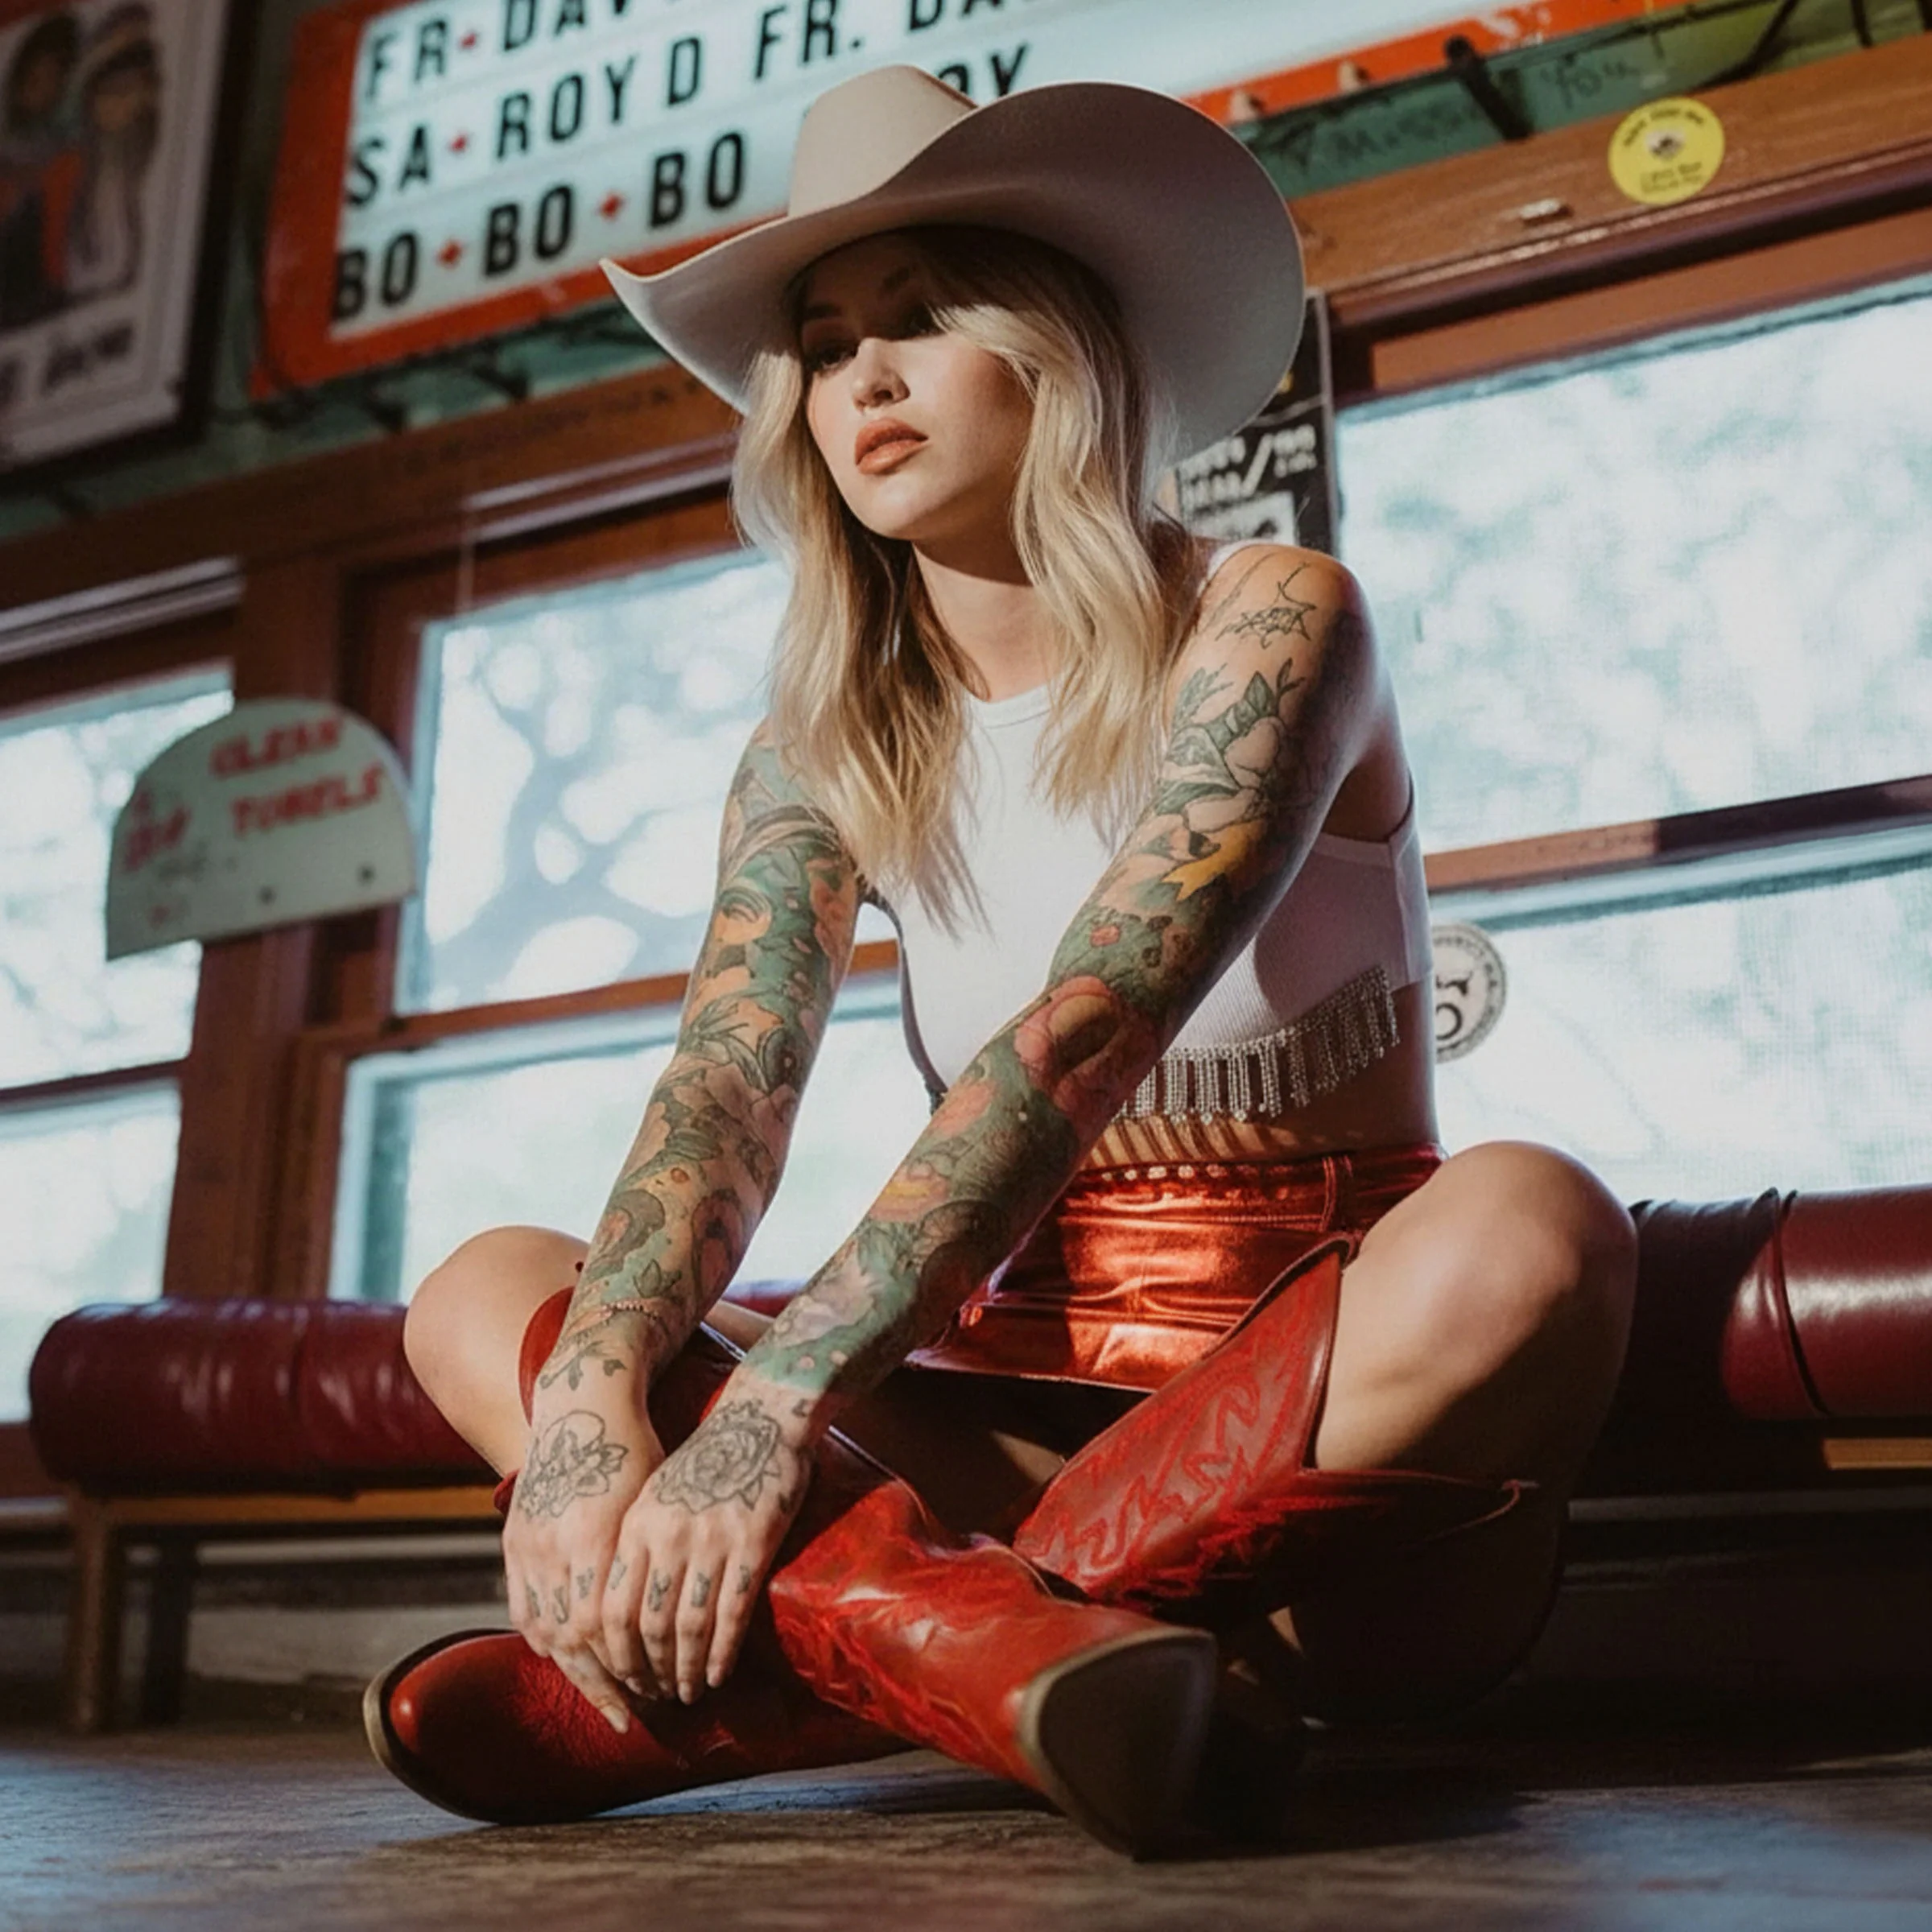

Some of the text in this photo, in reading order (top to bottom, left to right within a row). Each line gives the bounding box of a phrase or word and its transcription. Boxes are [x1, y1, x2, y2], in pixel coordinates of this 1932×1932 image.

[364, 19, 448, 100] FR
[344, 125, 430, 208] SA
[333, 232, 420, 320] BO
[481, 184, 575, 279] BO
[646, 131, 746, 229] BO
